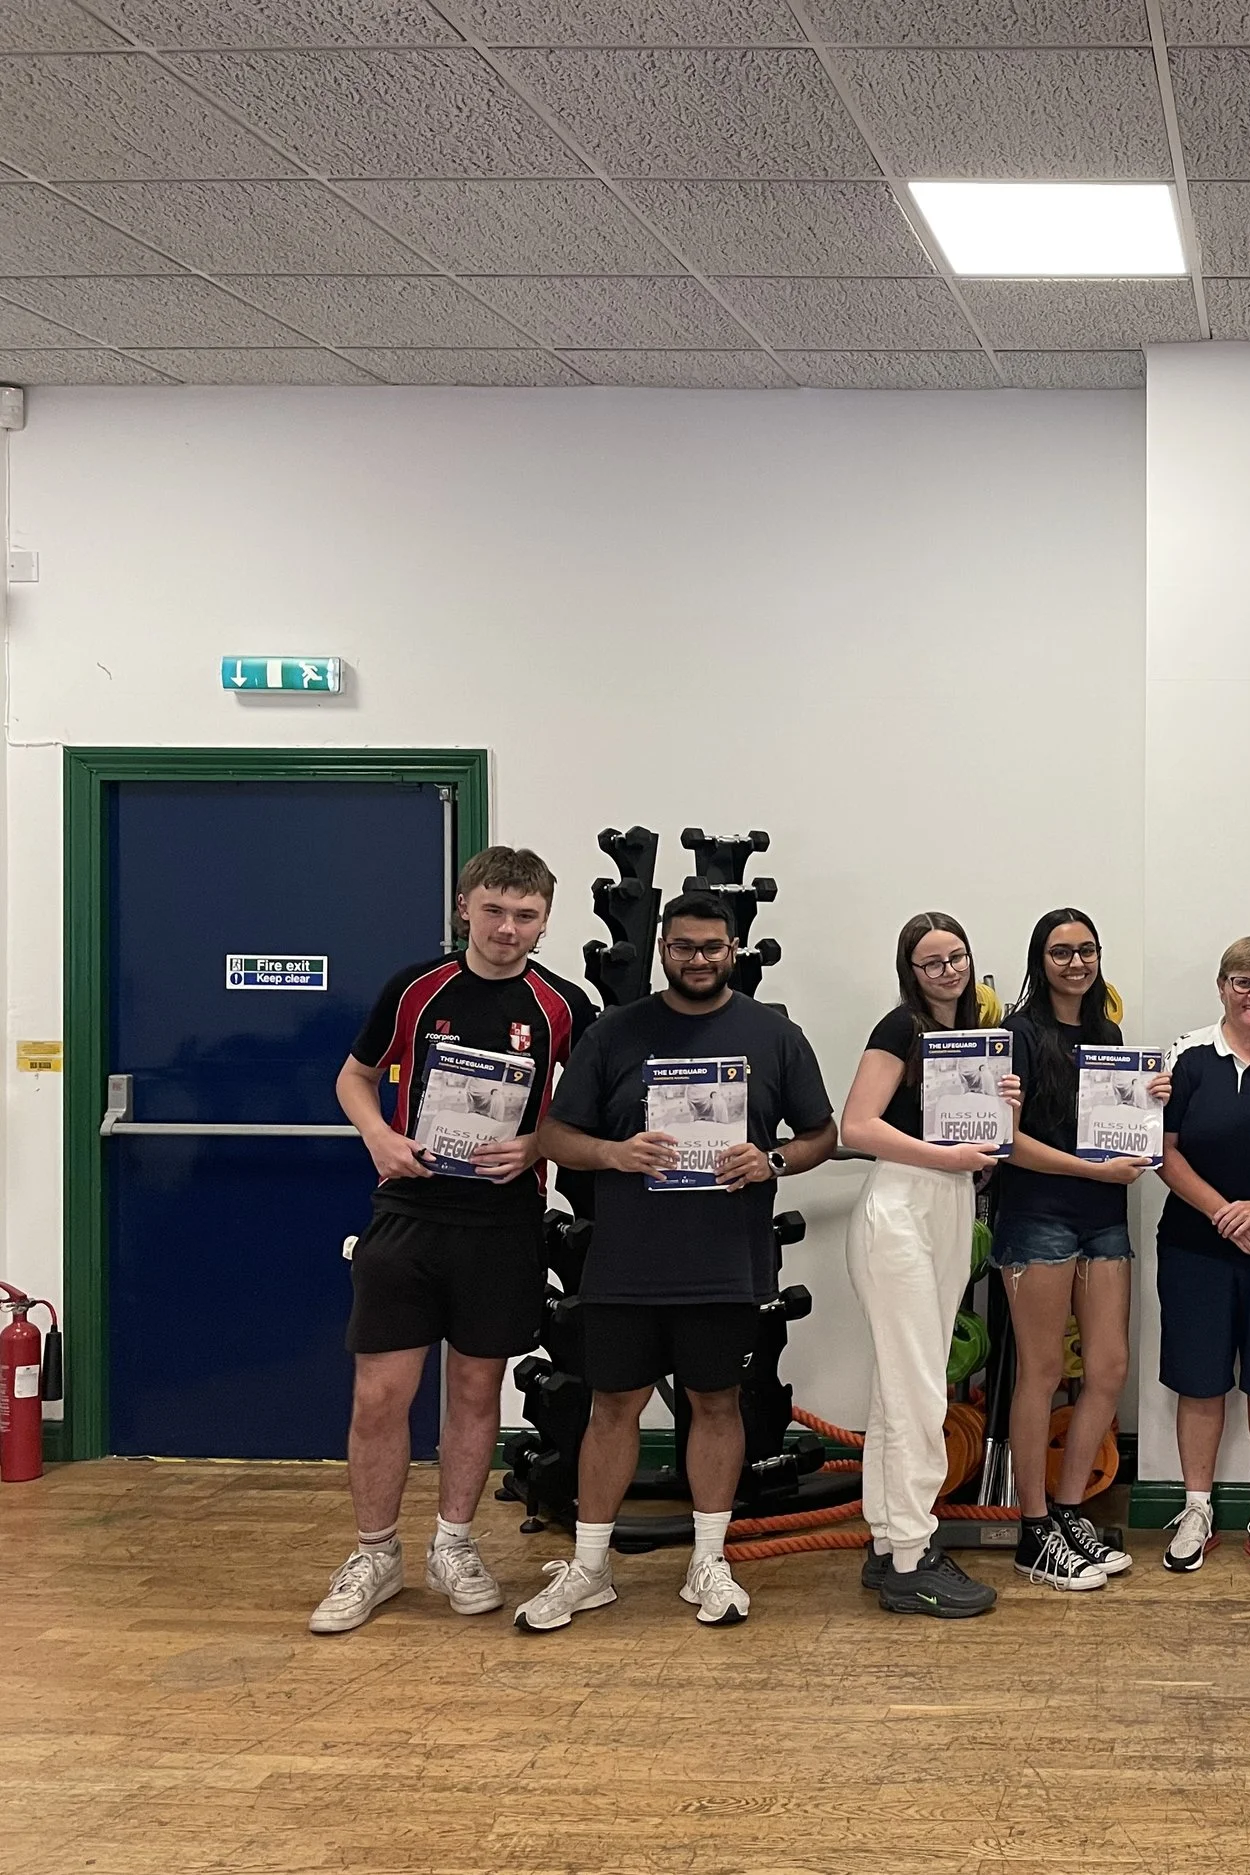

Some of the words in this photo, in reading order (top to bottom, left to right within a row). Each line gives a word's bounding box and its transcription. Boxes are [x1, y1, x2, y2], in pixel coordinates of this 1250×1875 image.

[256, 959, 282, 972] Fire
[286, 960, 310, 972] exit
[256, 973, 283, 985] Keep
[285, 974, 310, 984] clear
[425, 1033, 460, 1041] scorpion
[994, 1042, 1004, 1054] 9
[440, 1055, 456, 1065] THE
[455, 1059, 495, 1071] LIFEGUARD
[1147, 1058, 1156, 1070] 9
[513, 1071, 524, 1082] 9
[727, 1067, 737, 1080] 9
[940, 1121, 998, 1141] LIFEGUARD
[1093, 1130, 1148, 1152] LIFEGUARD
